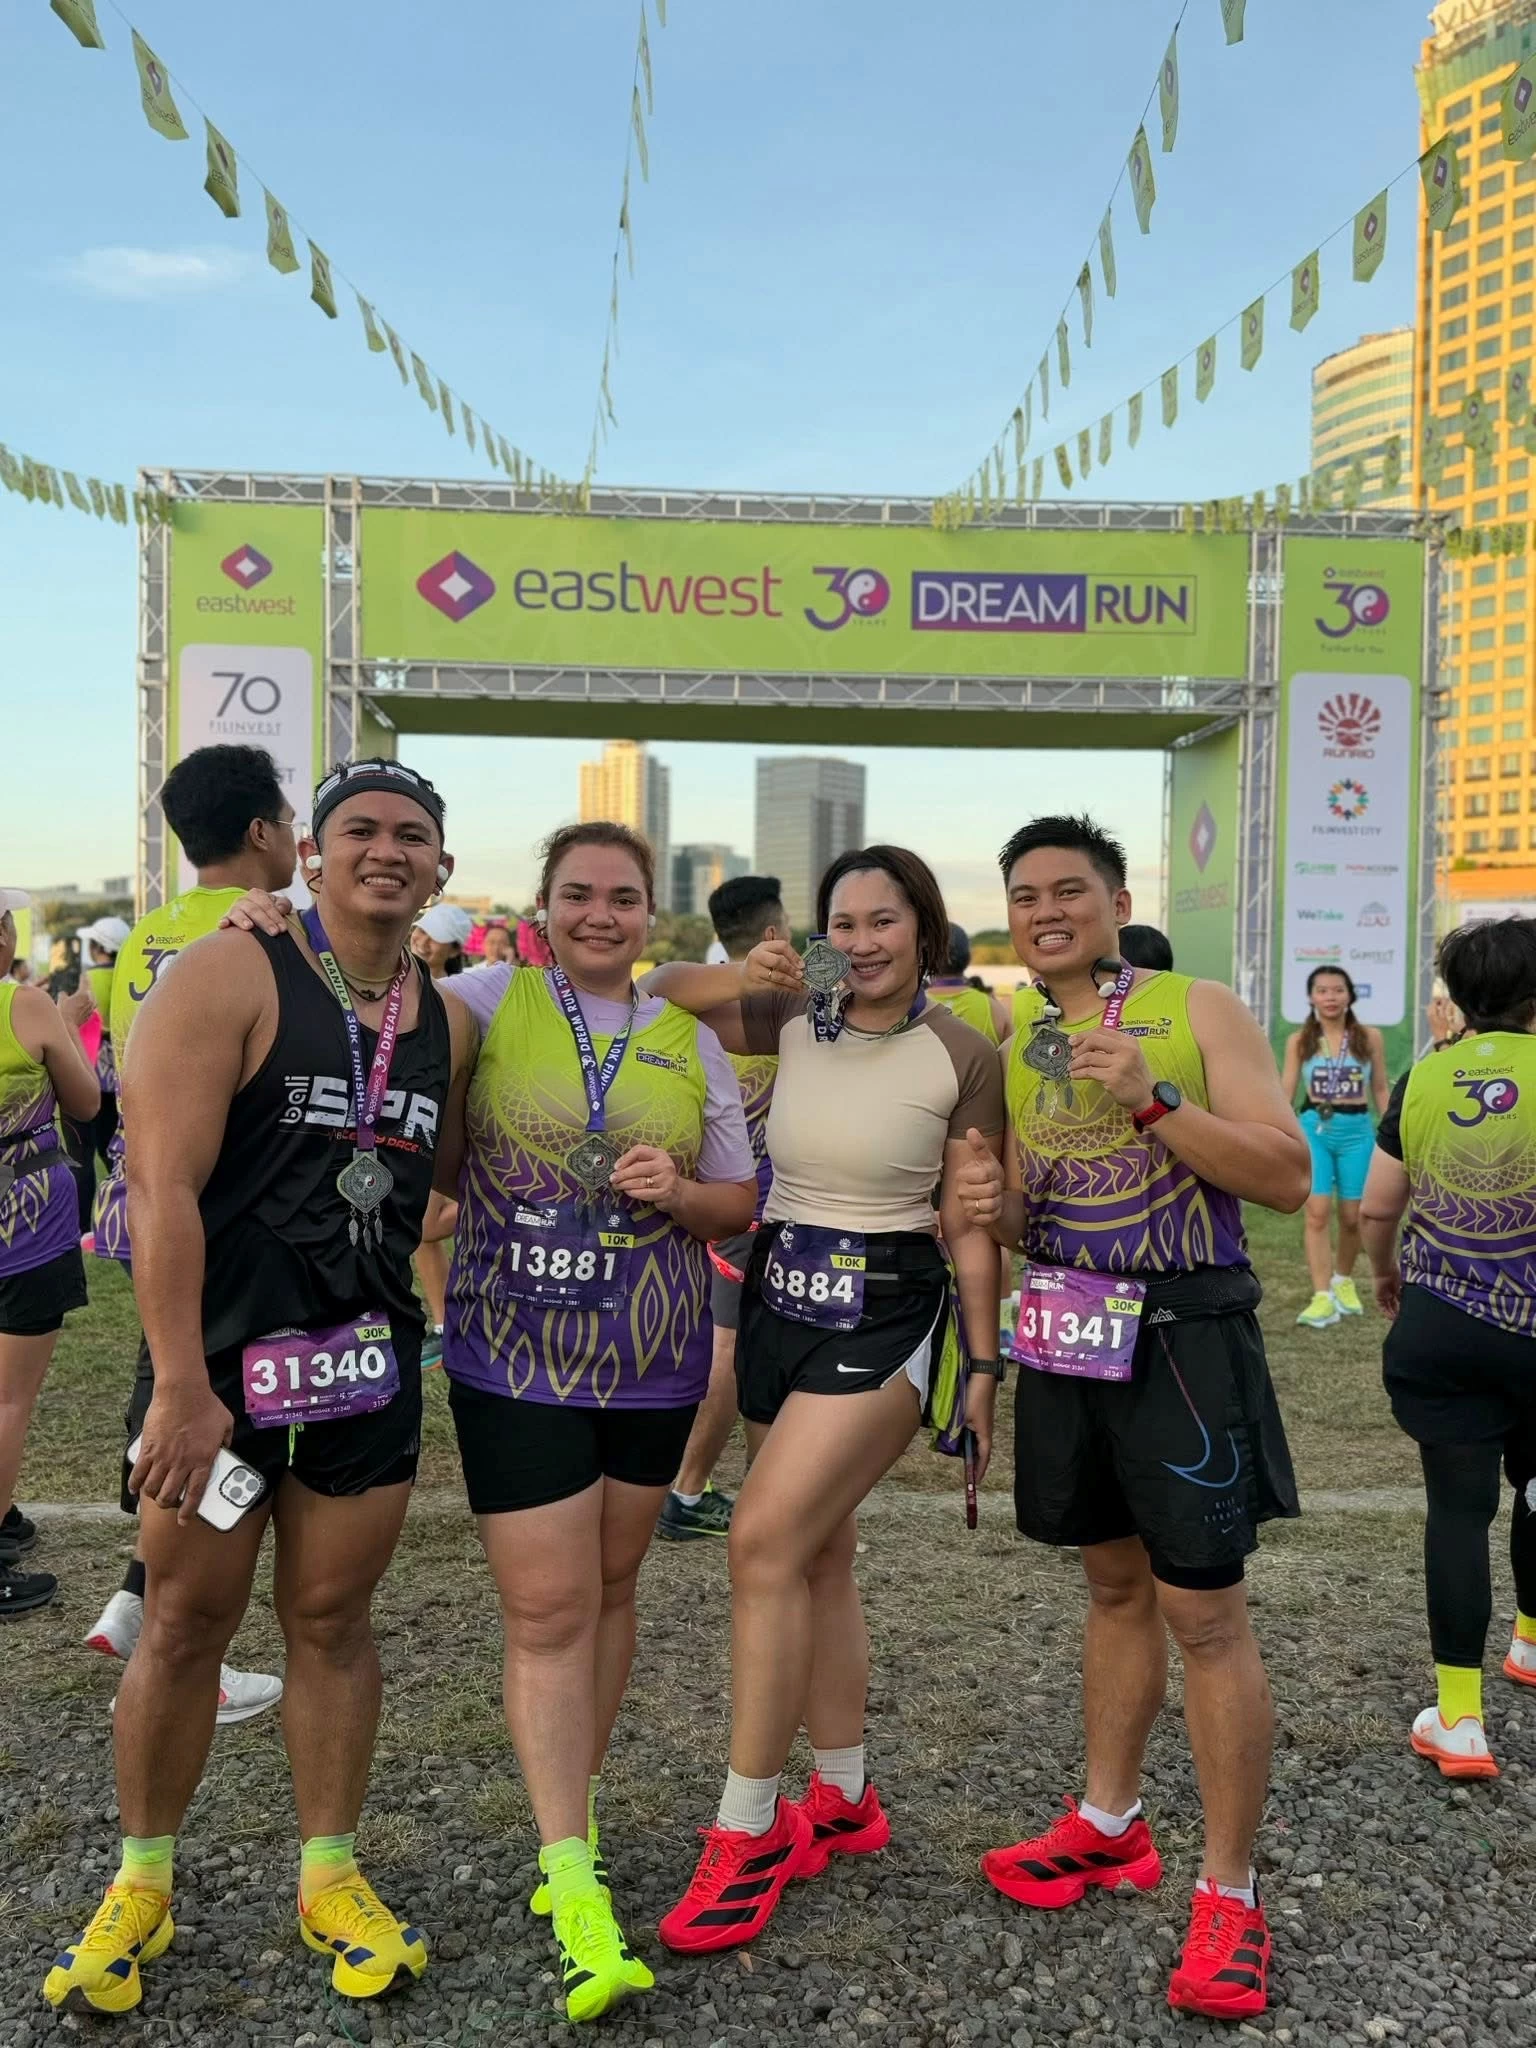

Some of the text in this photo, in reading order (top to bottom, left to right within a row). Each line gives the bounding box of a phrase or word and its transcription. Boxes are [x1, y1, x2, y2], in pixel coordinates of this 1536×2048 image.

[196, 594, 296, 616] eastwest
[515, 562, 891, 631] eastwest 30
[918, 580, 1187, 626] DREAM RUN
[1314, 582, 1390, 638] 30
[211, 672, 282, 718] 70
[323, 957, 349, 1004] MANILA
[1103, 968, 1133, 1027] RUN 2025
[346, 1015, 358, 1045] 30K
[380, 1001, 400, 1051] DREAM
[391, 969, 407, 998] RUN
[561, 988, 578, 1013] RUN
[571, 1014, 592, 1052] DREAM
[608, 1042, 624, 1062] 10K
[1149, 1027, 1169, 1036] RUN
[639, 1054, 687, 1073] DREAM RUN
[1467, 1065, 1515, 1077] eastwest
[279, 1075, 310, 1124] bali
[1447, 1078, 1519, 1128] 30
[510, 1241, 617, 1281] 13881
[607, 1235, 629, 1246] 10K
[838, 1256, 861, 1268] 10K
[1048, 1281, 1064, 1290] RUN
[1111, 1300, 1137, 1313] 30K
[363, 1327, 387, 1339] 30K
[1022, 1307, 1123, 1349] 31341
[250, 1346, 387, 1395] 31340
